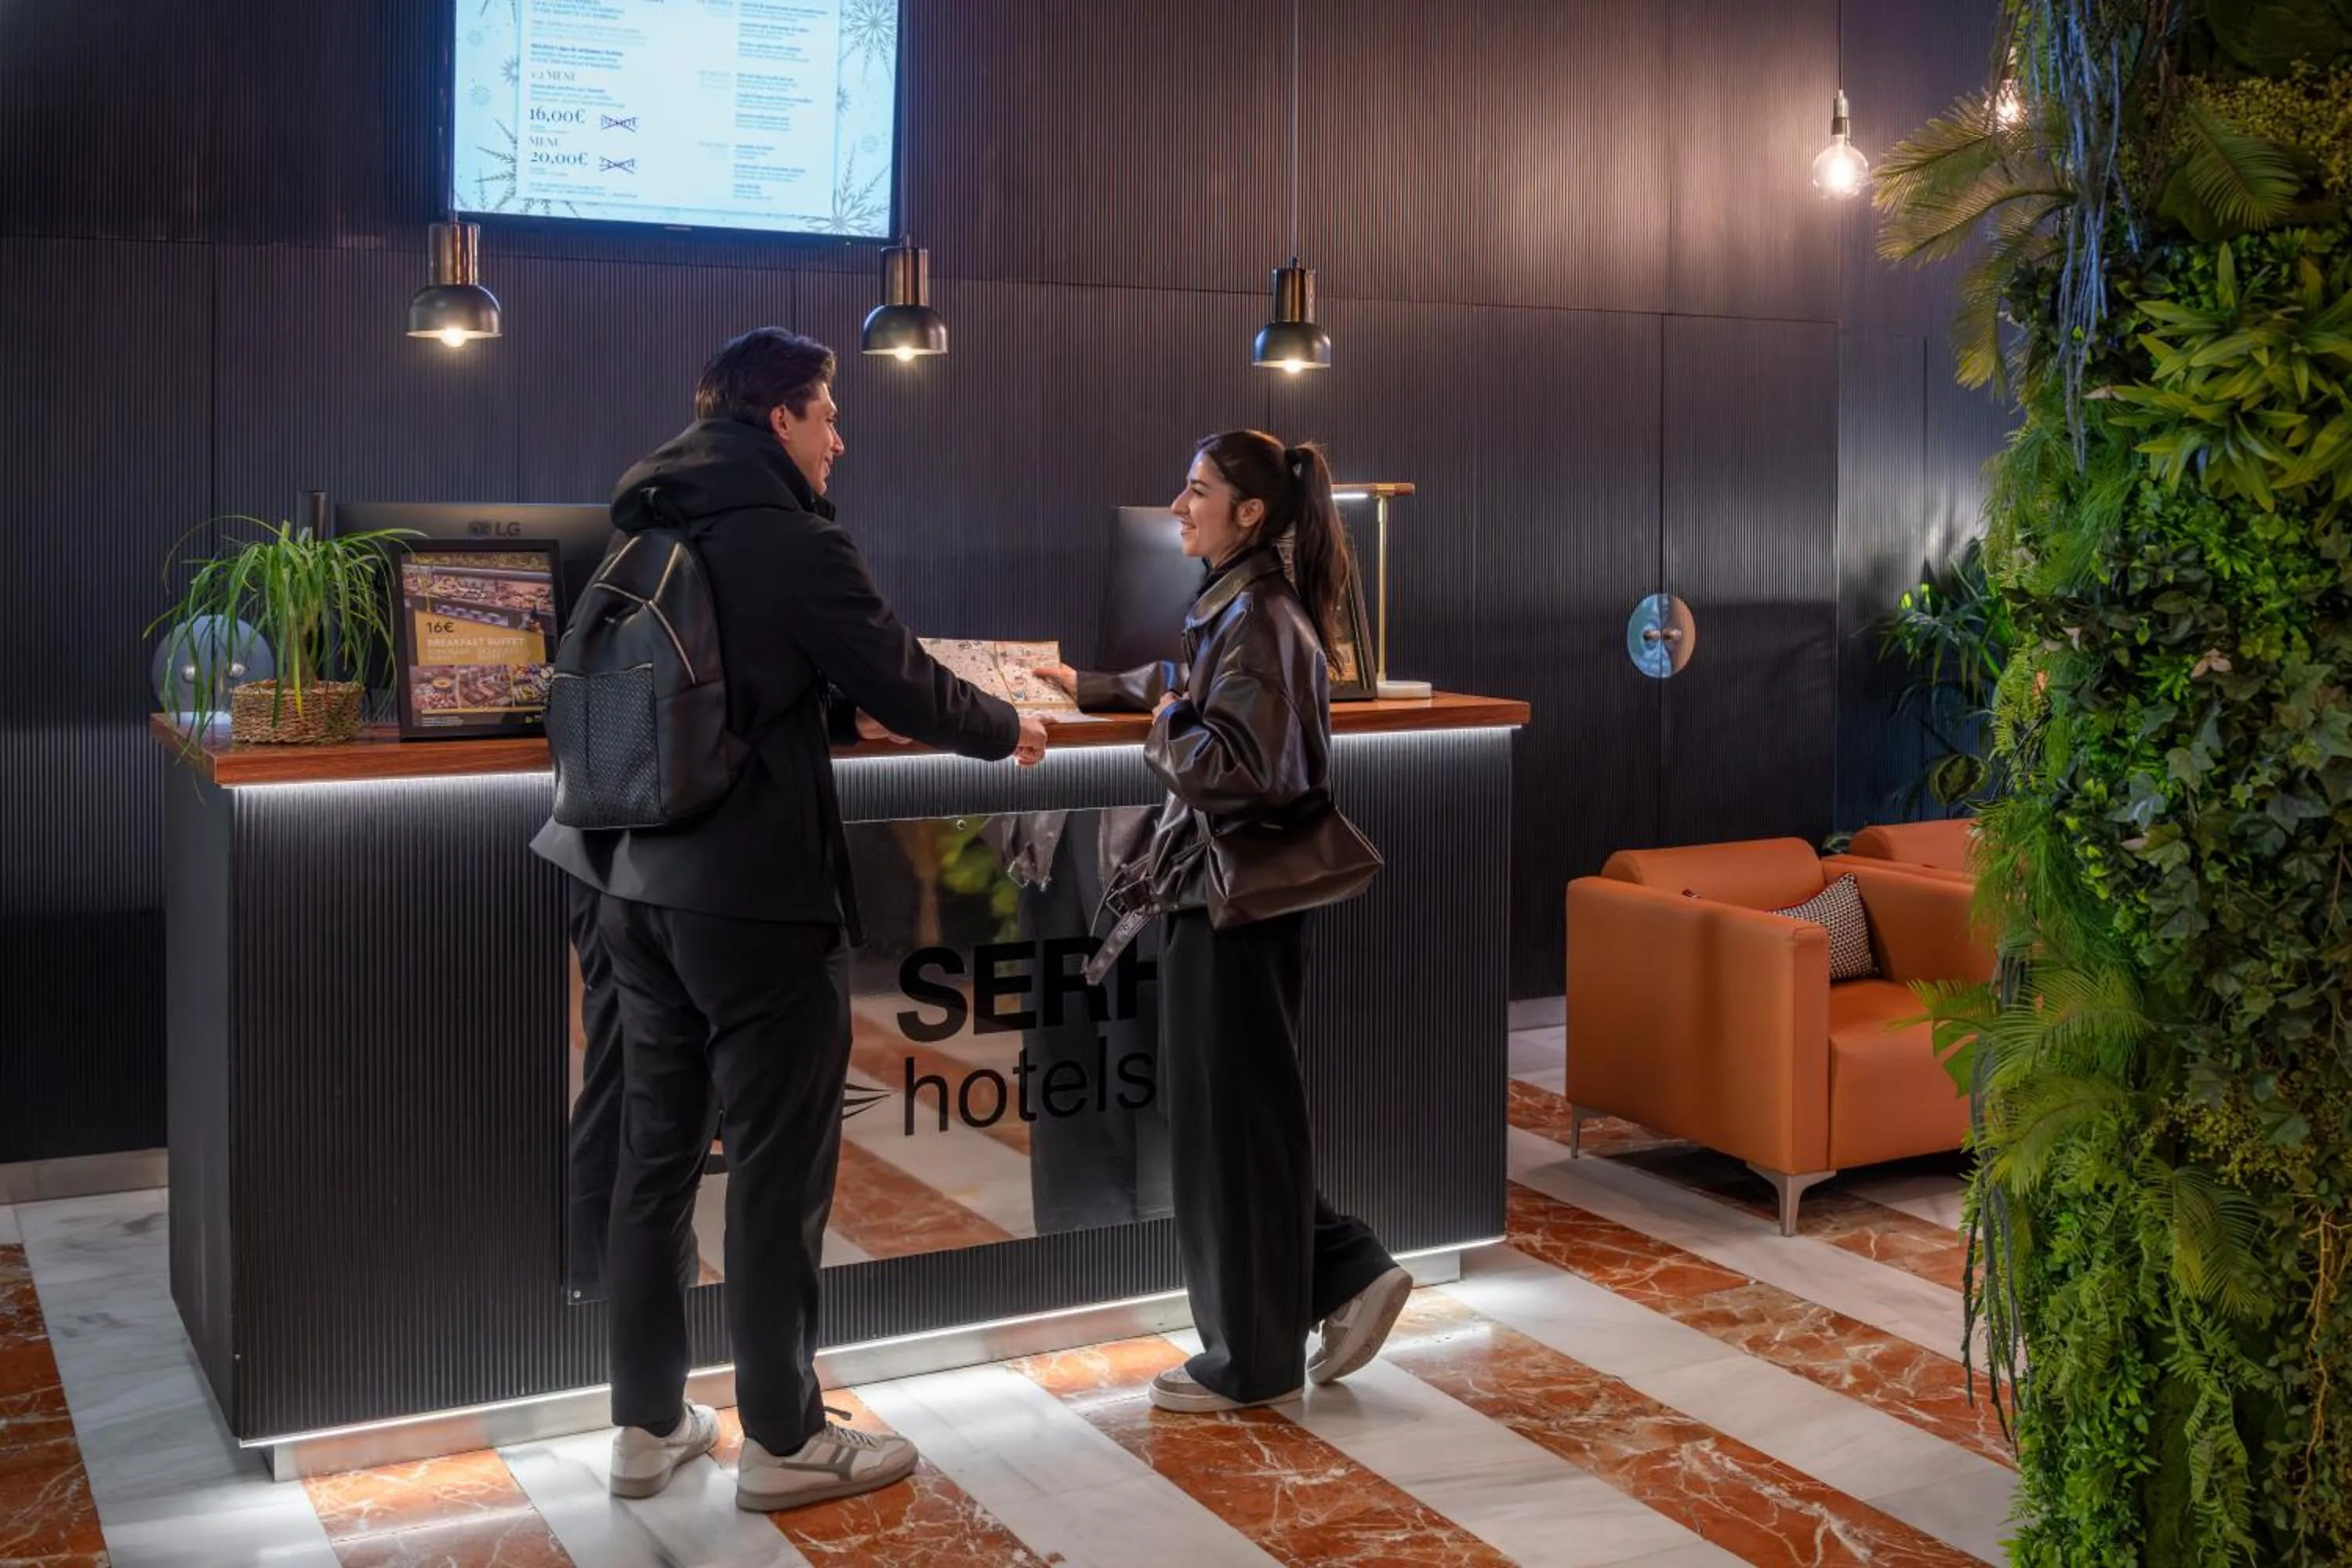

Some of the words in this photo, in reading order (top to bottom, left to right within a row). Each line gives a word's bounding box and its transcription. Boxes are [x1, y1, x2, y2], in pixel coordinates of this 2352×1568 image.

[495, 521, 521, 537] LG
[426, 622, 455, 634] 16€
[426, 637, 485, 648] BREAKFAST
[487, 637, 525, 646] BUFFET
[904, 1036, 1156, 1136] hotels
